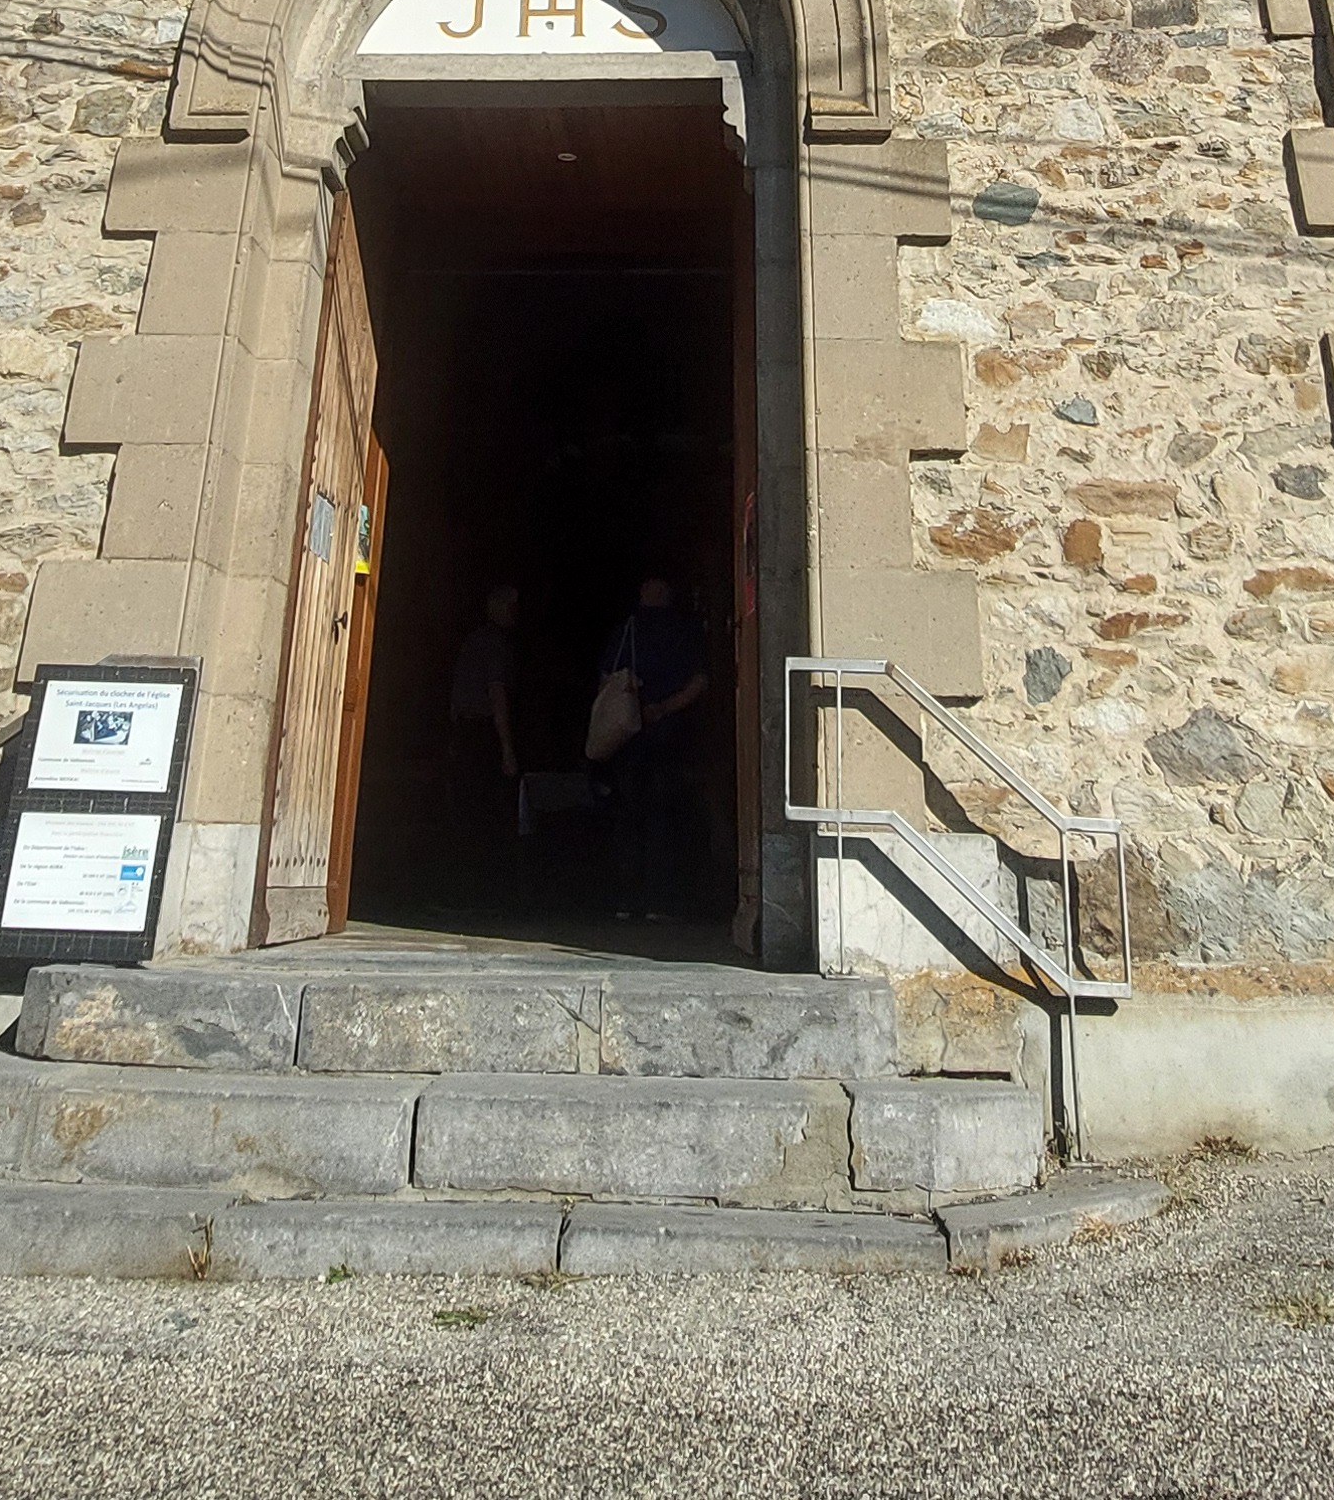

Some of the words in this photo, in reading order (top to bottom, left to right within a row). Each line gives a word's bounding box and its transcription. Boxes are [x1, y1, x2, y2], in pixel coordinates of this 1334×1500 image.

[56, 689, 98, 698] Sécurisation
[100, 690, 109, 698] du
[110, 690, 135, 699] clocher
[136, 690, 145, 698] de
